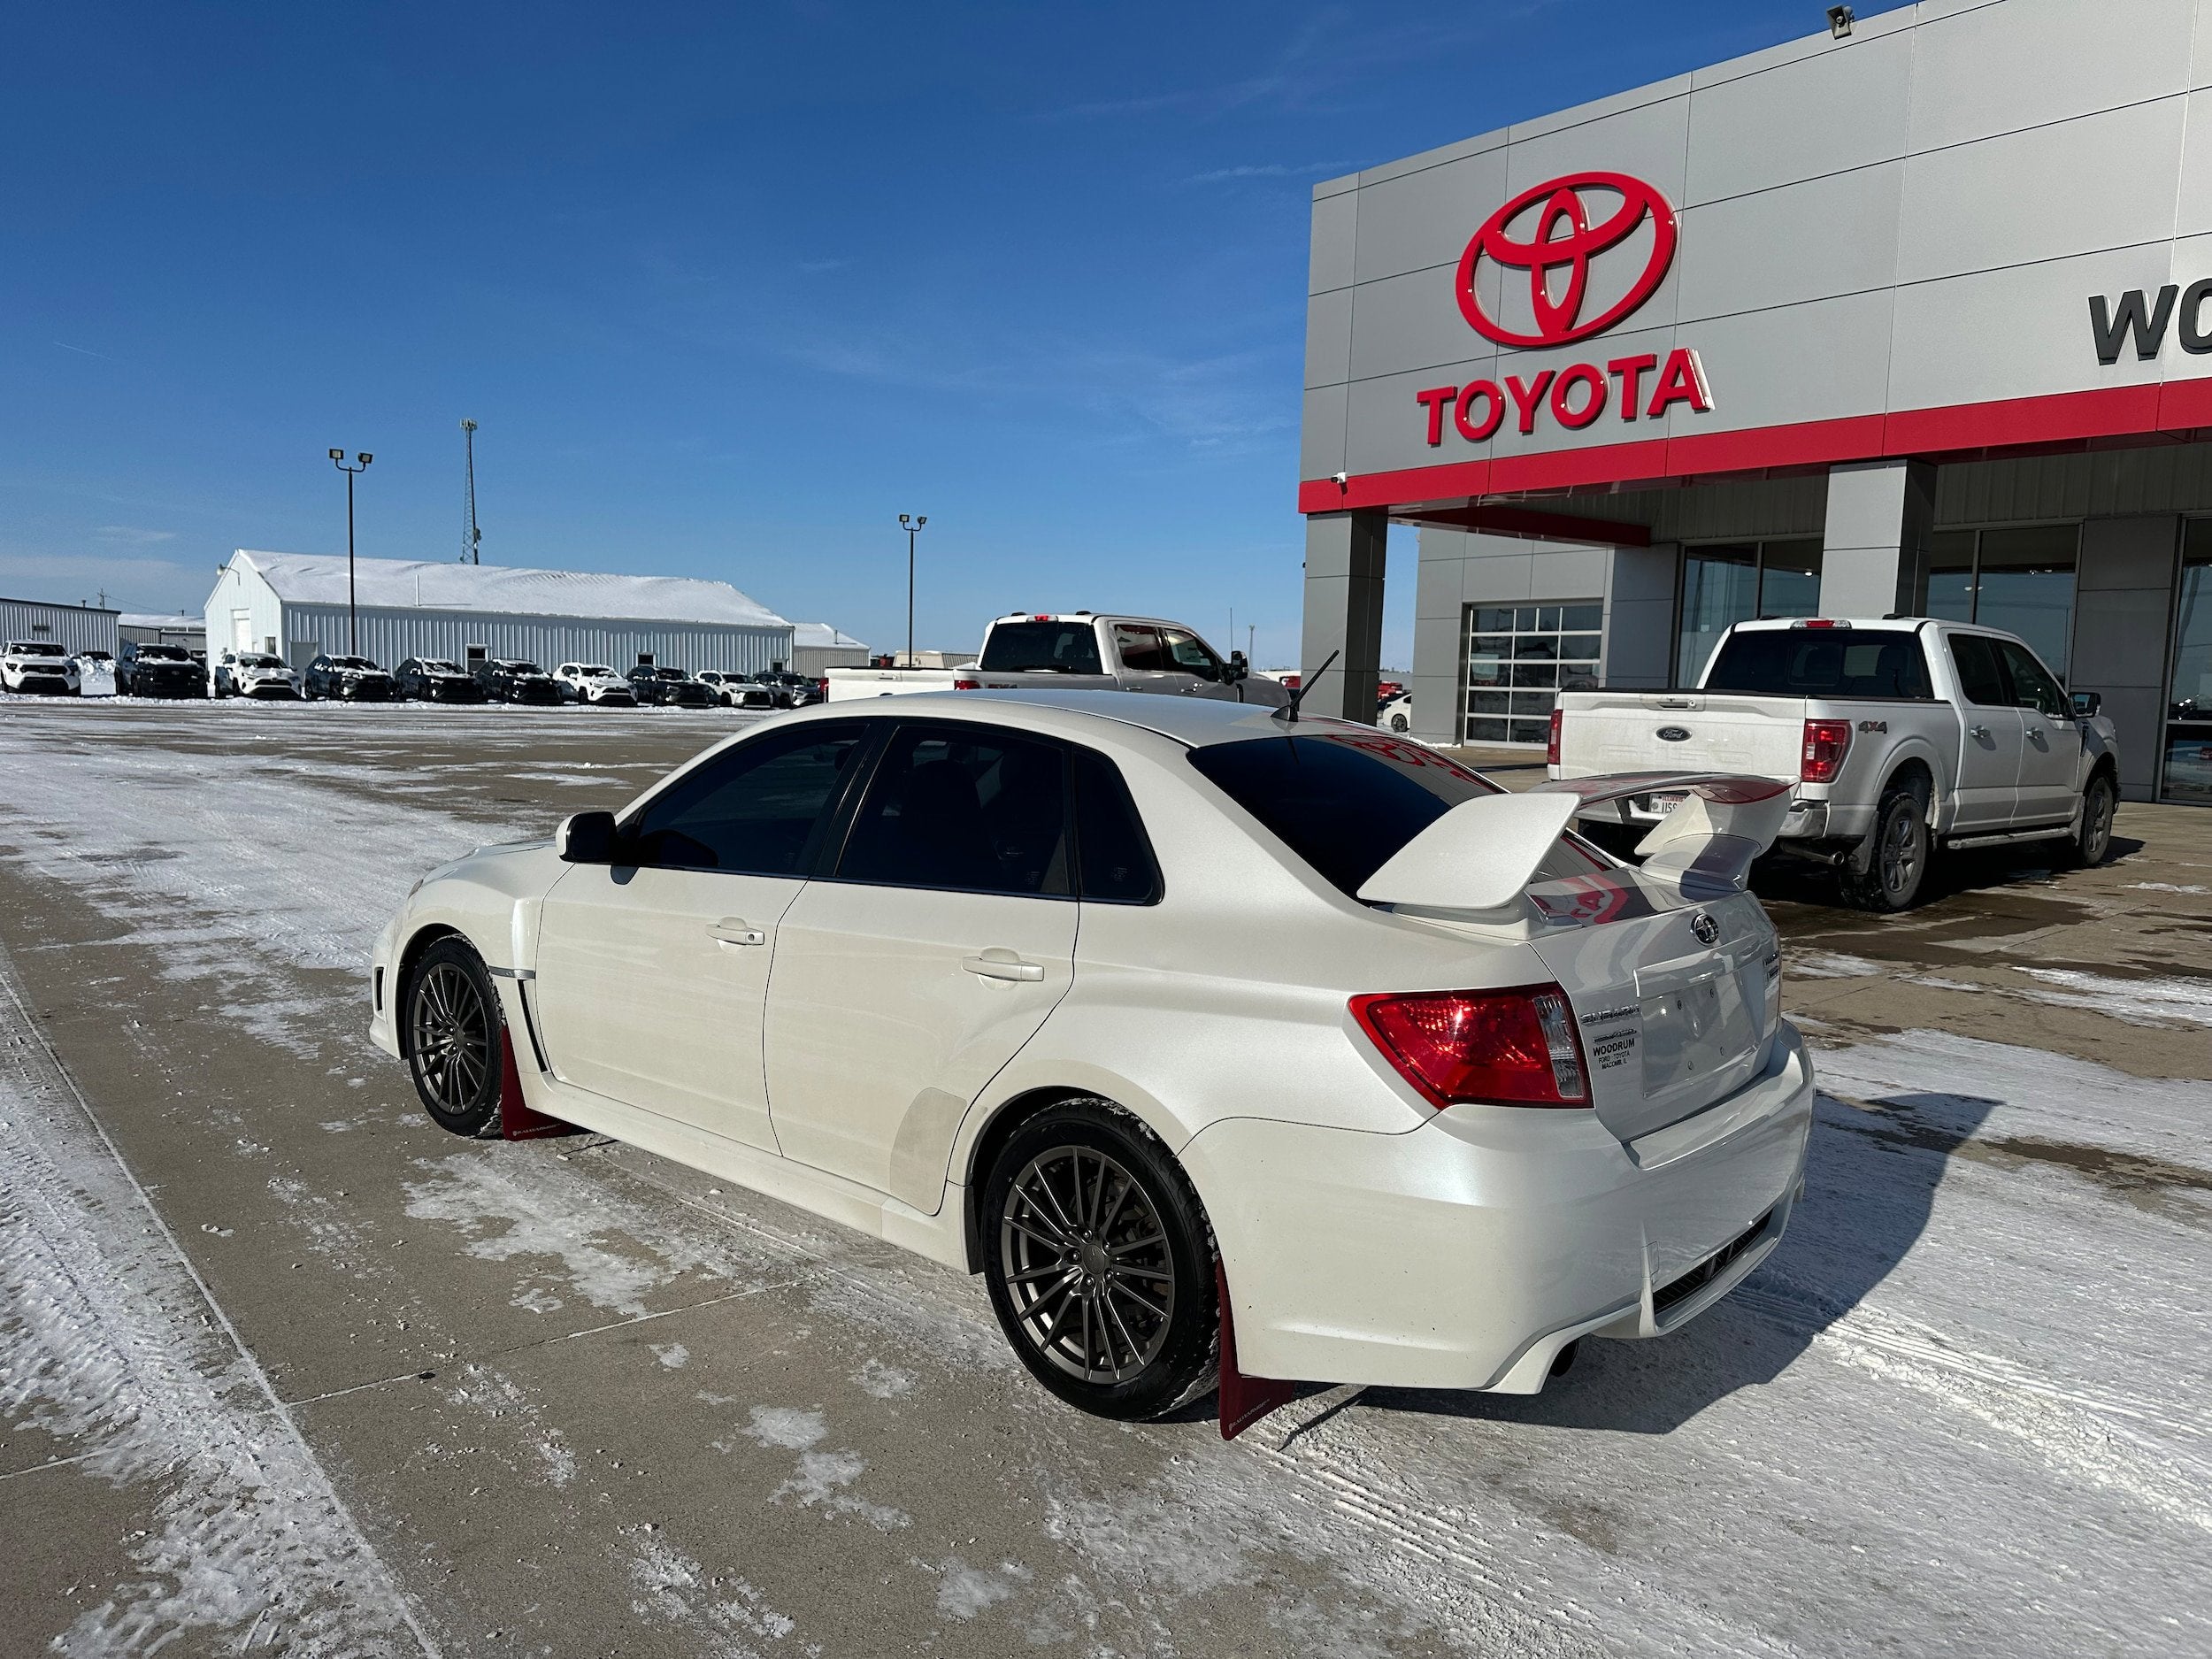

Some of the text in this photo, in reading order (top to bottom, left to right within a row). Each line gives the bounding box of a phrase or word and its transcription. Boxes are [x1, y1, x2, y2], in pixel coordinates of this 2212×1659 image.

[1417, 349, 1715, 447] TOYOTA
[1663, 729, 1683, 739] Ford
[1594, 1038, 1635, 1056] WOODRUM
